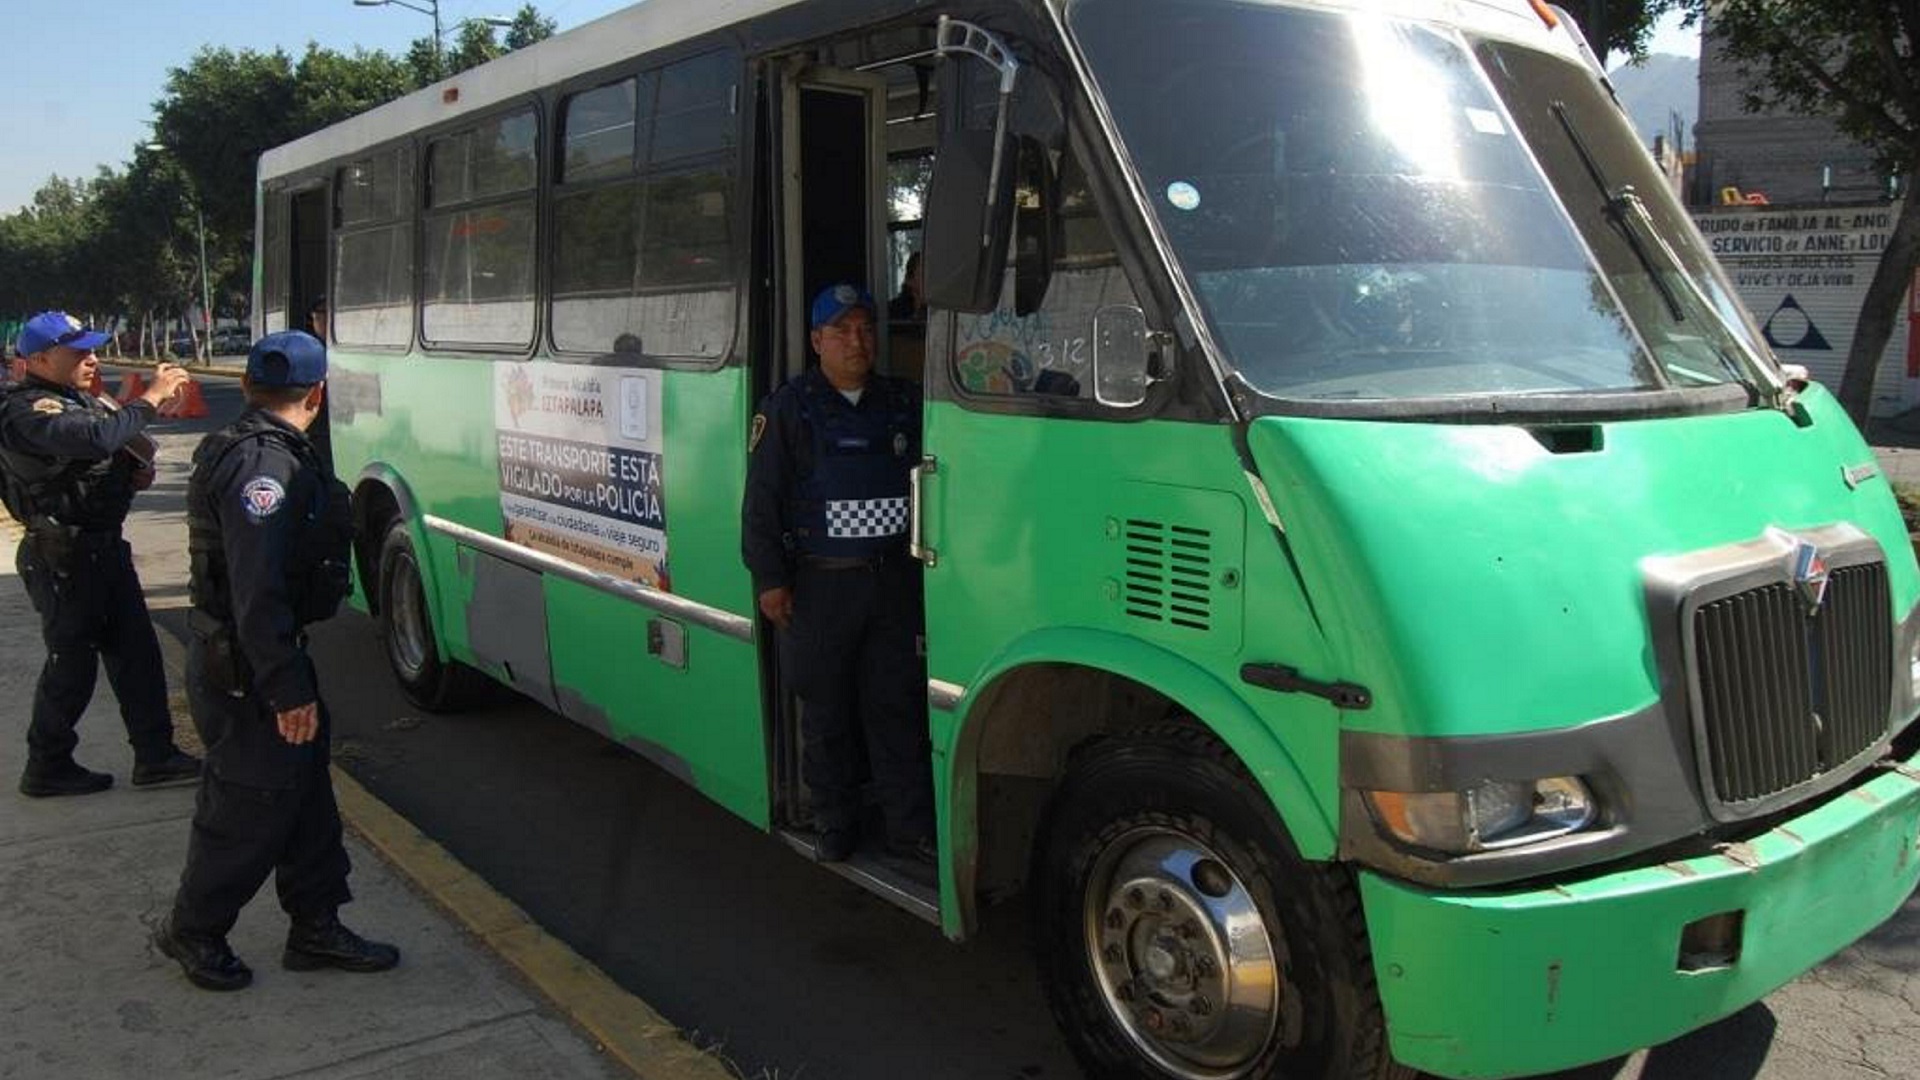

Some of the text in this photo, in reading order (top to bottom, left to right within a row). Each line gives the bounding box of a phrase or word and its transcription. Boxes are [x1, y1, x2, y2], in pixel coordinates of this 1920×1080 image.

[1712, 236, 1781, 253] SERVICIO
[1804, 235, 1848, 251] ANNE
[500, 437, 660, 487] ESTE TRANSPORTE ESTÁ
[501, 463, 562, 498] VIGILADO
[597, 483, 662, 522] POLICÍA
[628, 534, 660, 553] seguro
